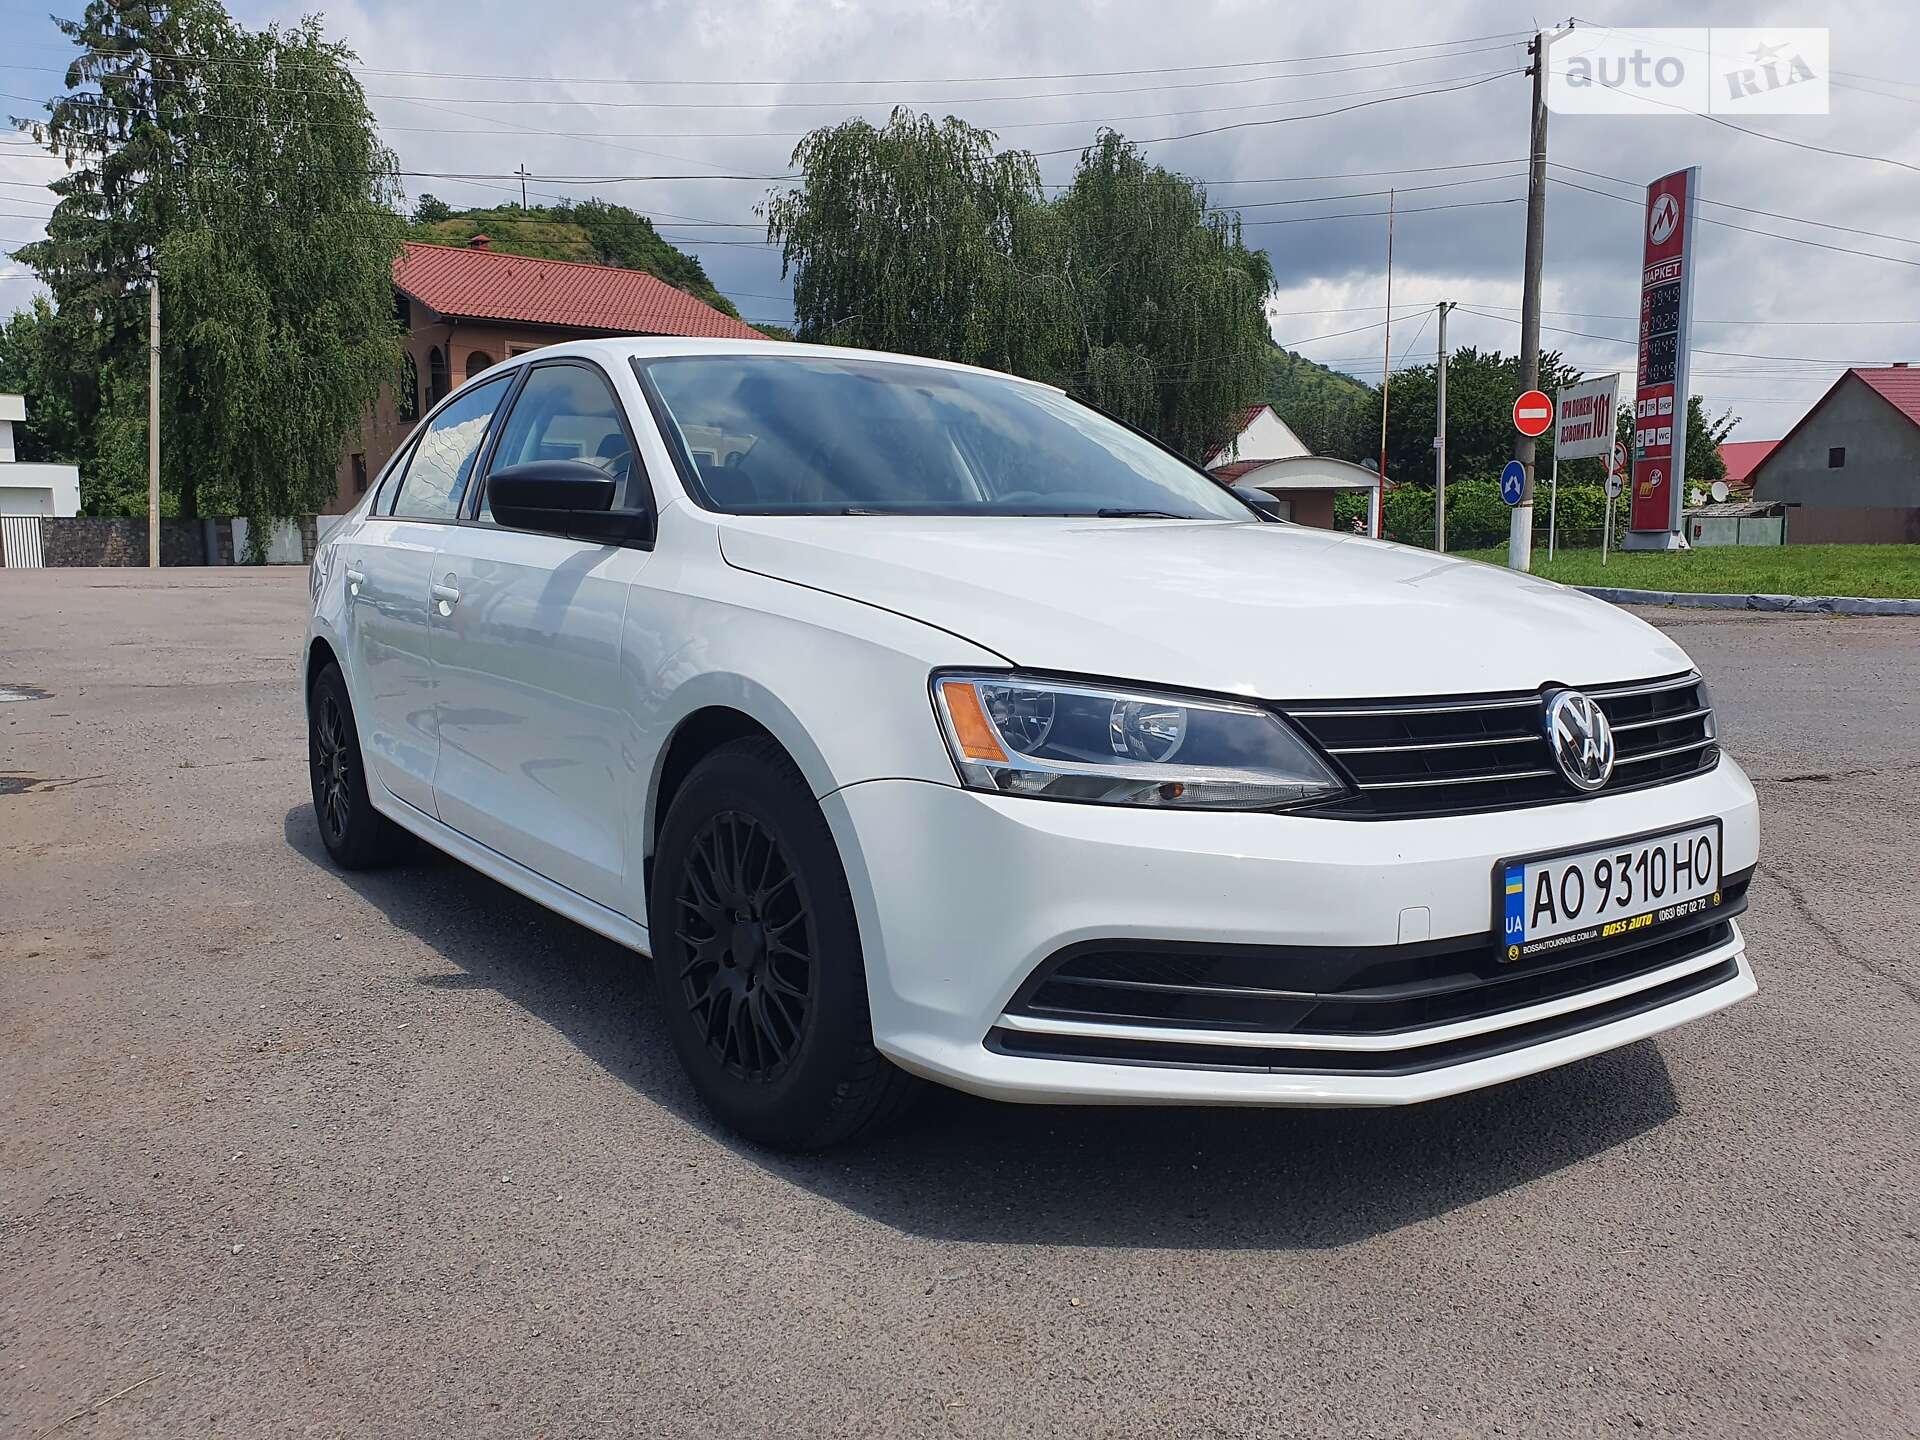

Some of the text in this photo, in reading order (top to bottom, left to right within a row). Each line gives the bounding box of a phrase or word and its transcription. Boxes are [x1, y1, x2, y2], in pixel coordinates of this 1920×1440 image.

[1644, 263, 1681, 284] МАРКЕТ
[1593, 393, 1610, 438] 101
[1659, 432, 1670, 440] WC
[1531, 835, 1712, 929] AO 9310 HO
[1505, 915, 1523, 934] UA
[1522, 930, 1598, 954] BOSSAUTOUKRAINE.COM.UA
[1602, 920, 1627, 937] BOSS
[1658, 907, 1676, 921] (063)
[1676, 903, 1688, 917] 667
[1698, 898, 1706, 910] 72
